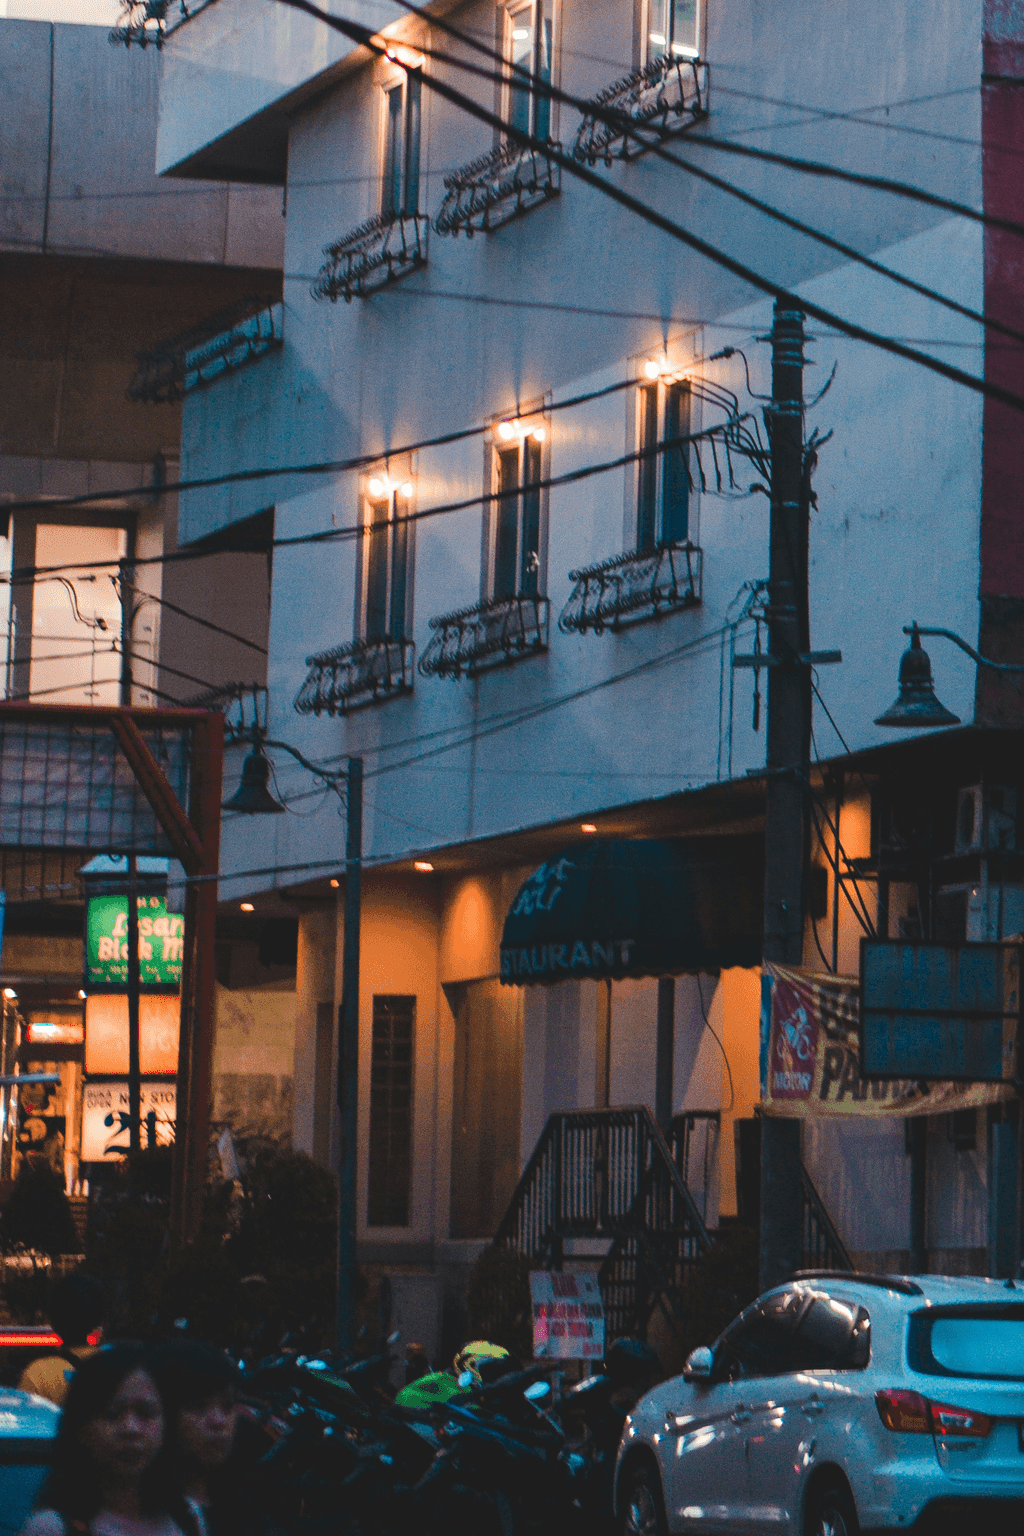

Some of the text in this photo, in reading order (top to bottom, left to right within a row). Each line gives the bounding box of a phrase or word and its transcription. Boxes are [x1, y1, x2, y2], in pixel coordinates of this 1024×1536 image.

[501, 939, 636, 976] STAURANT
[119, 1091, 175, 1104] NN STO
